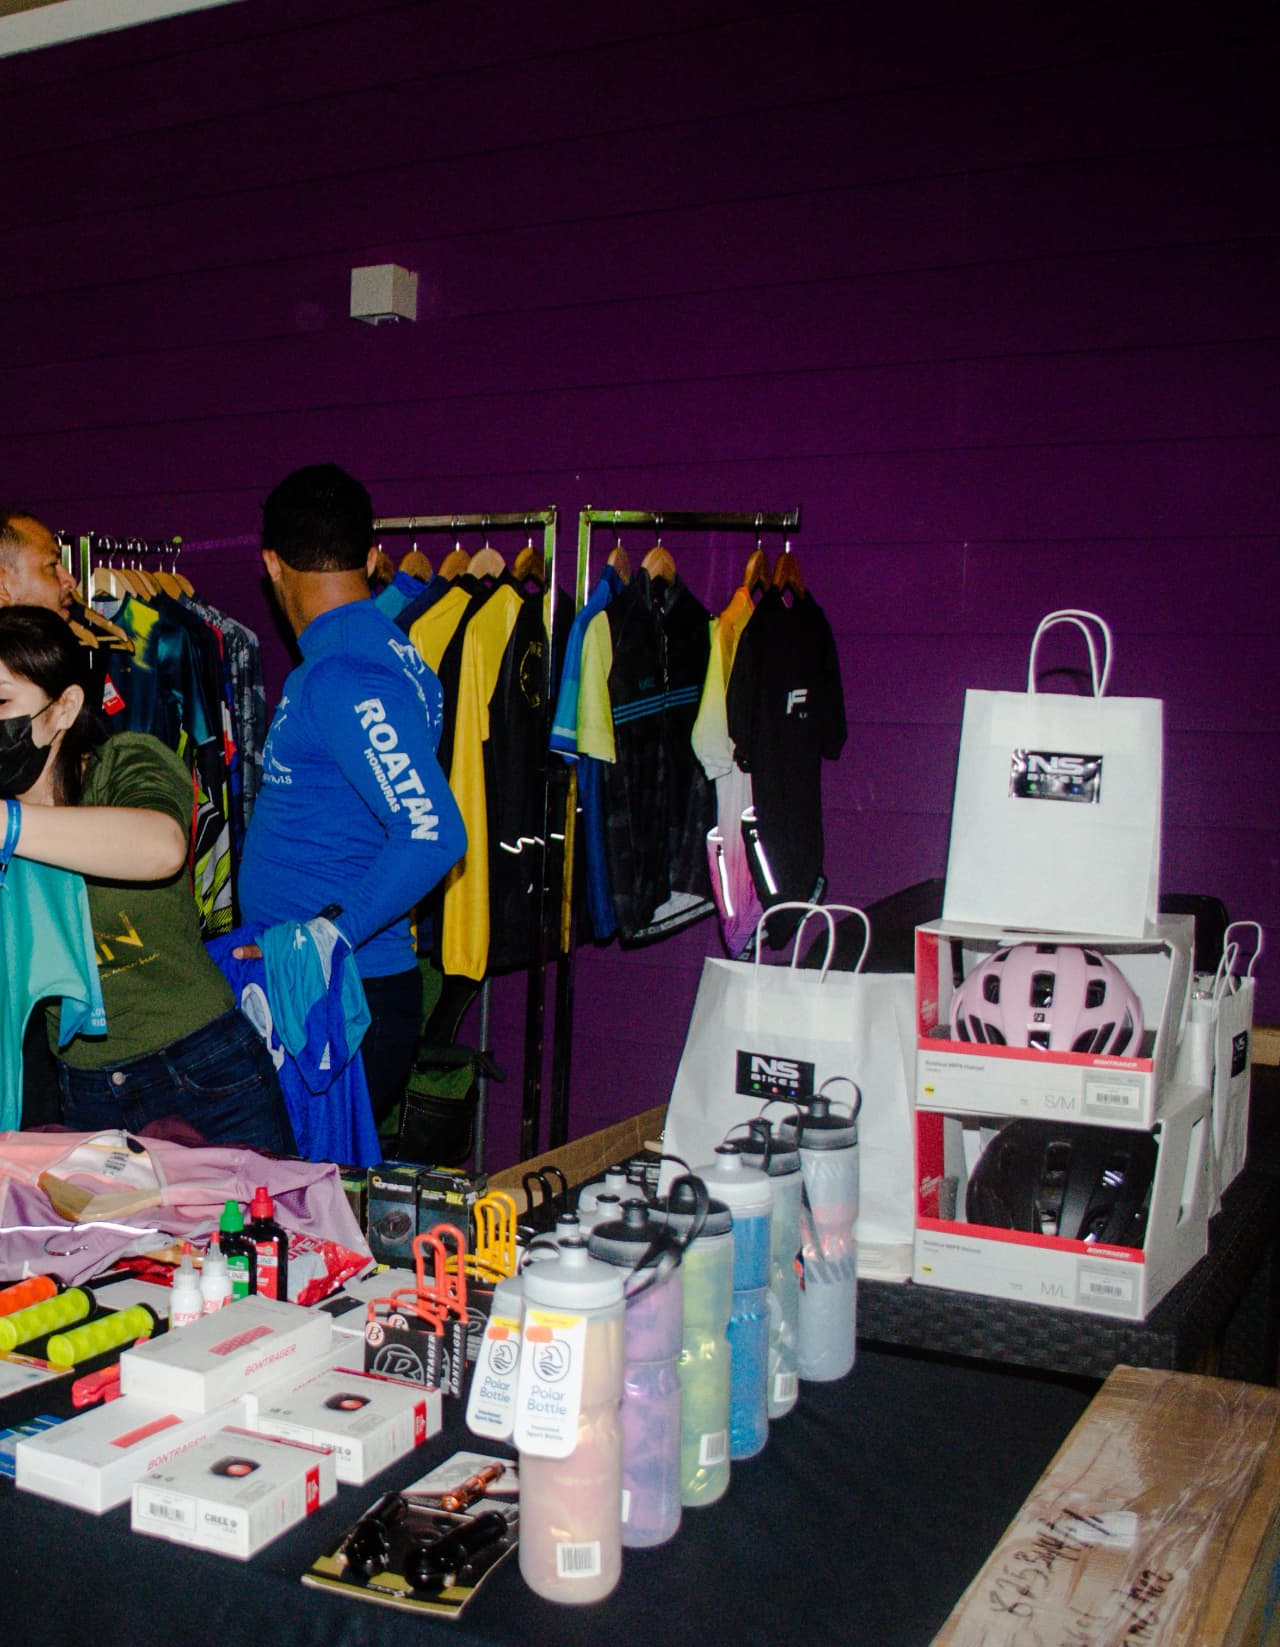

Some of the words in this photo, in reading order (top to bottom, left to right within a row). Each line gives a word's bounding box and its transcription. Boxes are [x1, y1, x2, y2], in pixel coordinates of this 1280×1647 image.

[354, 698, 440, 841] ROATAN
[1028, 755, 1085, 775] NS
[364, 748, 401, 813] HONDURAS
[751, 1056, 800, 1080] NS
[750, 1073, 800, 1088] BIKES
[1044, 1094, 1076, 1111] S/M
[244, 1344, 297, 1376] BONTRAGER
[484, 1376, 511, 1391] Polar
[480, 1387, 511, 1402] Bottle
[531, 1385, 567, 1400] Polar
[527, 1399, 568, 1415] Bottle
